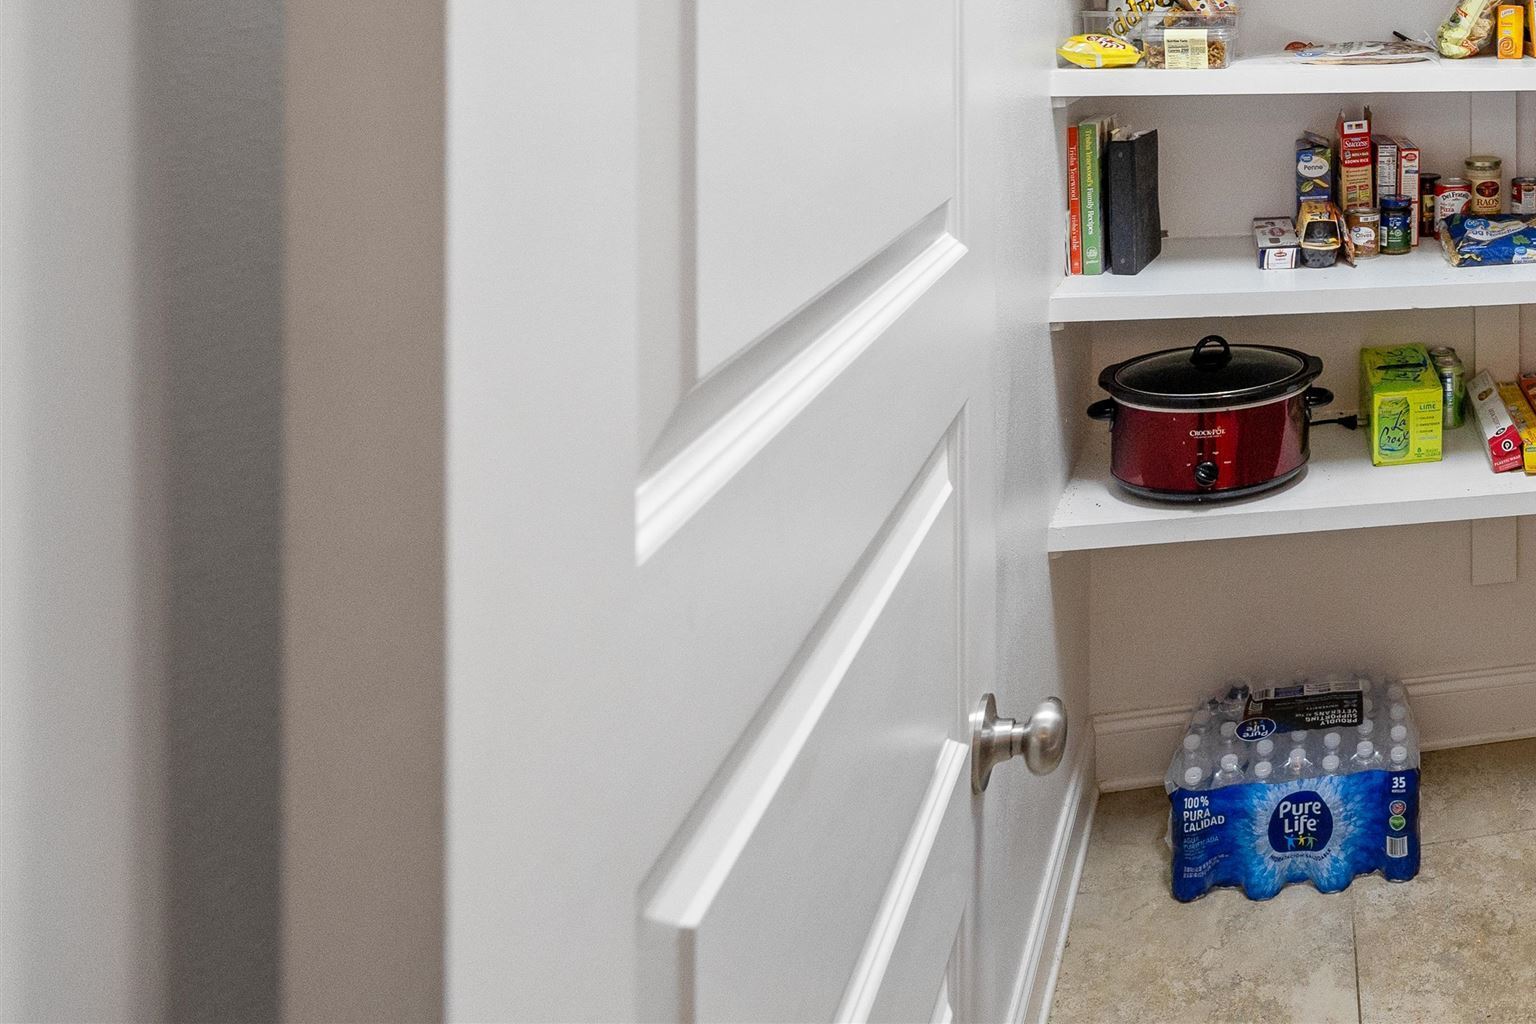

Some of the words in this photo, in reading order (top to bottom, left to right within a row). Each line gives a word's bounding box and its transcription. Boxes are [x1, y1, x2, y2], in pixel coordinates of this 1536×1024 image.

[1304, 163, 1323, 171] Penne
[1086, 188, 1094, 209] Family
[1476, 198, 1500, 206] RAO'S
[1087, 210, 1095, 235] Recipes
[1391, 411, 1406, 431] La
[1189, 426, 1226, 437] CROCK-POT
[1380, 427, 1409, 447] Croix
[1305, 713, 1358, 722] SUPPORTING
[1314, 708, 1358, 717] VETERANS
[1320, 717, 1358, 726] PROUDLY
[1242, 729, 1269, 739] Pure
[1392, 776, 1406, 788] 35
[1184, 796, 1209, 809] 100%
[1183, 808, 1211, 822] PURA
[1279, 801, 1322, 819] Pure
[1183, 815, 1225, 833] CALIDAD
[1284, 815, 1318, 834] Life
